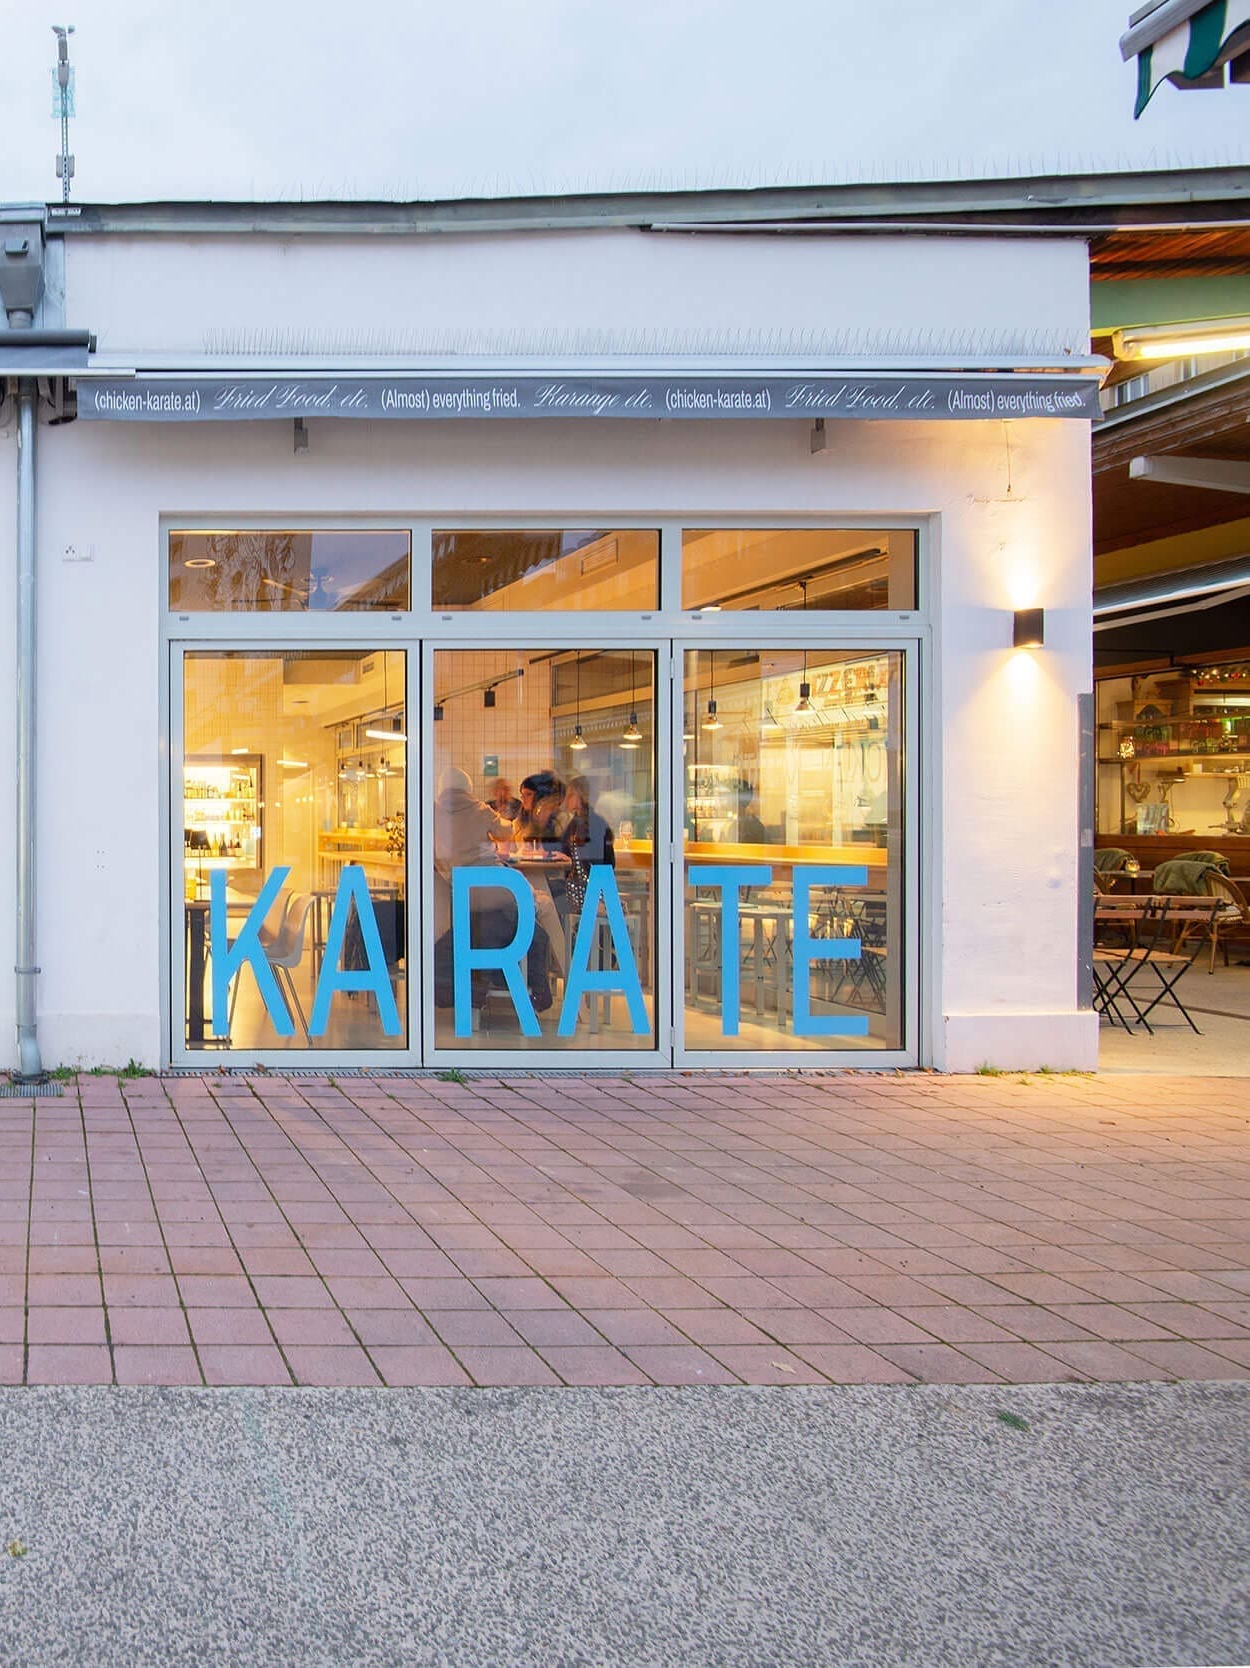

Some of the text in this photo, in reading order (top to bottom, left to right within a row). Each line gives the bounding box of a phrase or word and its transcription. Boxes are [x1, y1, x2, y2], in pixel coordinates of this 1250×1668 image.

[94, 389, 201, 413] (chicken-karate.at)
[213, 384, 278, 411] Fried
[381, 388, 430, 411] (Almost)
[432, 387, 490, 412] everything
[492, 387, 521, 408] fried.
[533, 383, 620, 416] Karaage
[665, 388, 771, 411] (chicken-karate.at)
[784, 383, 847, 409] Fried
[947, 389, 995, 412] (Almost)
[997, 389, 1054, 413] everything
[1053, 391, 1087, 411] fried.
[212, 865, 867, 1036] KARATE
